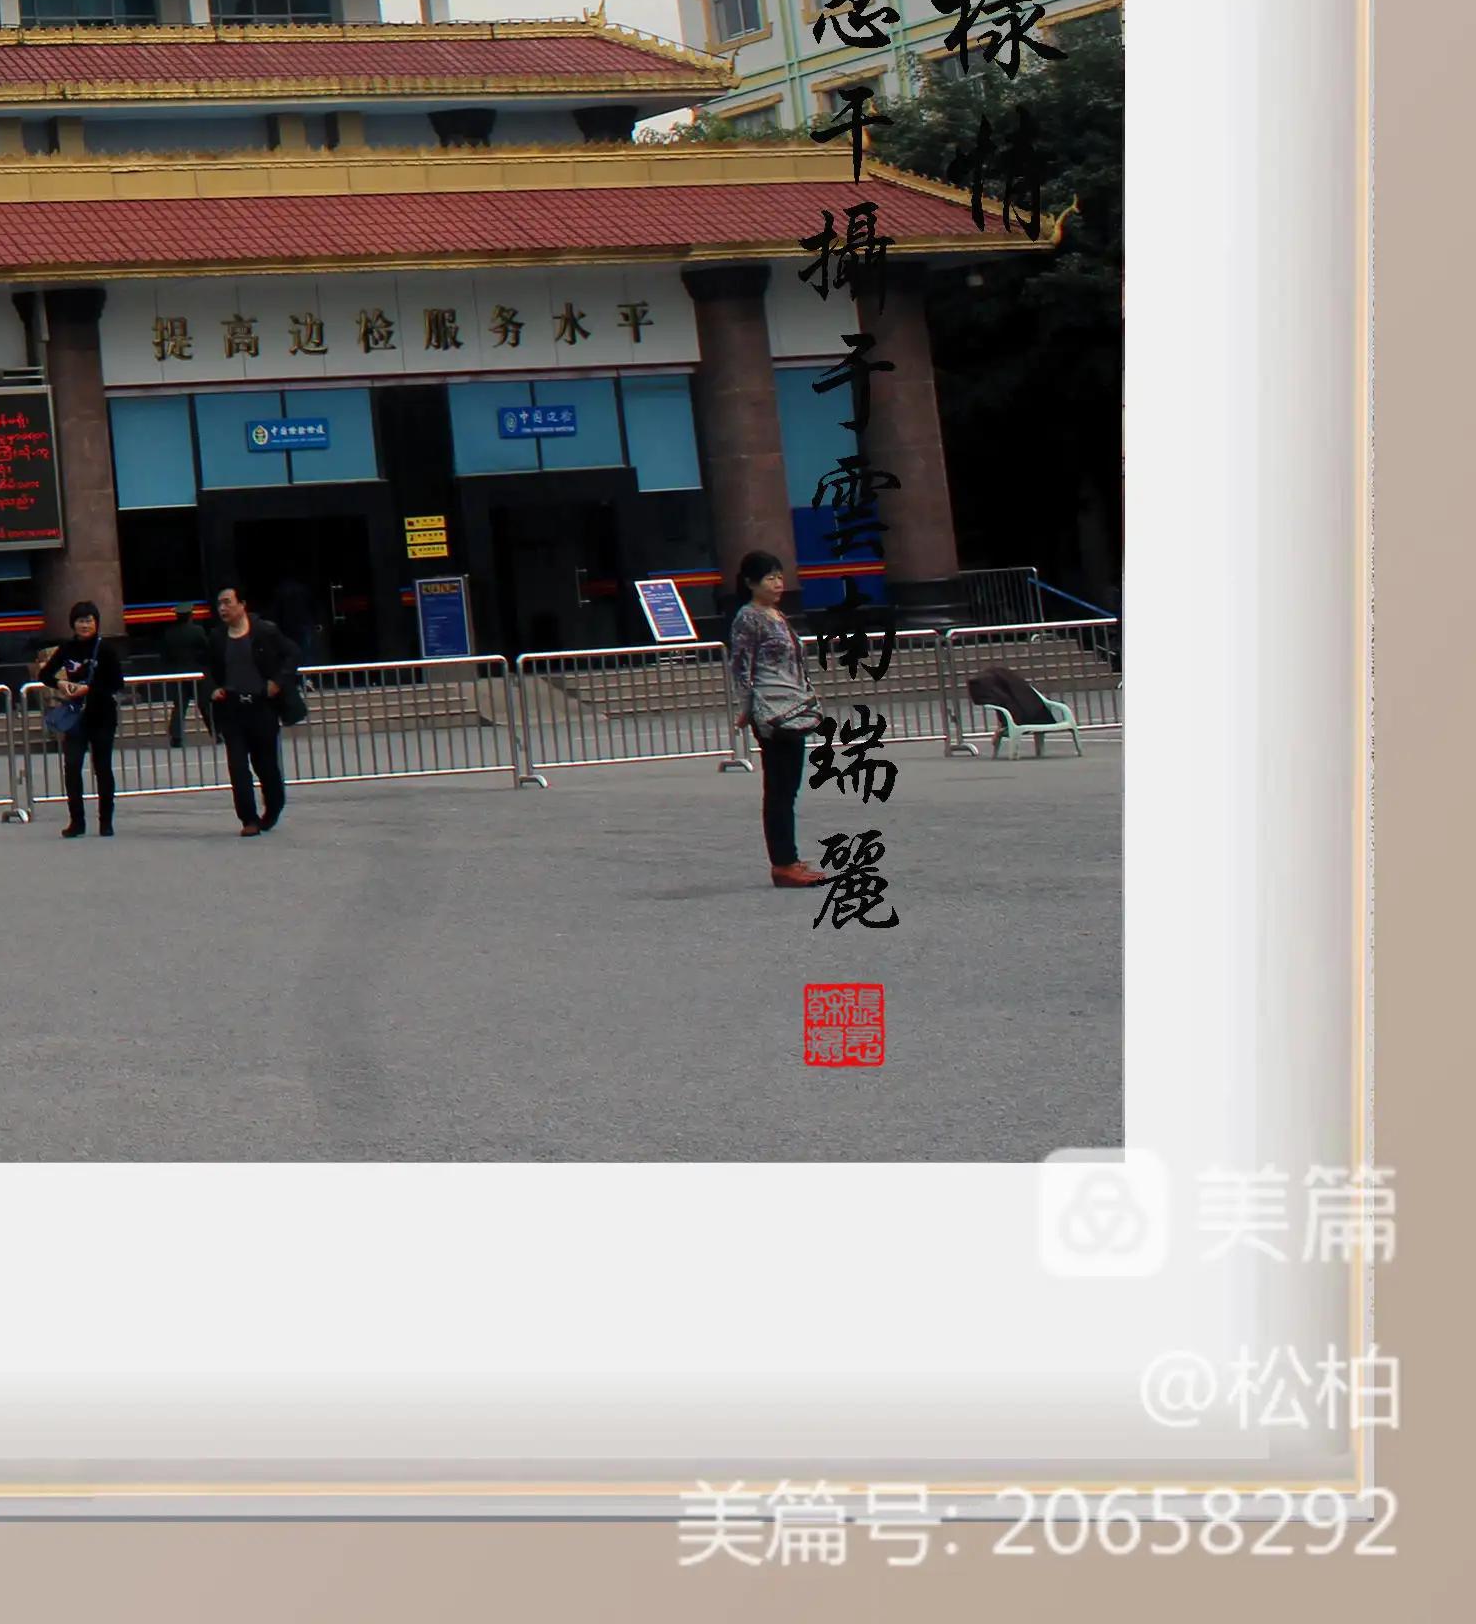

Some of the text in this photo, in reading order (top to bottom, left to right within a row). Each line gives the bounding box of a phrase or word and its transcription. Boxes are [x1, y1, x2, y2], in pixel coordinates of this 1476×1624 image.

[152, 300, 654, 362] 提高边检服务水平
